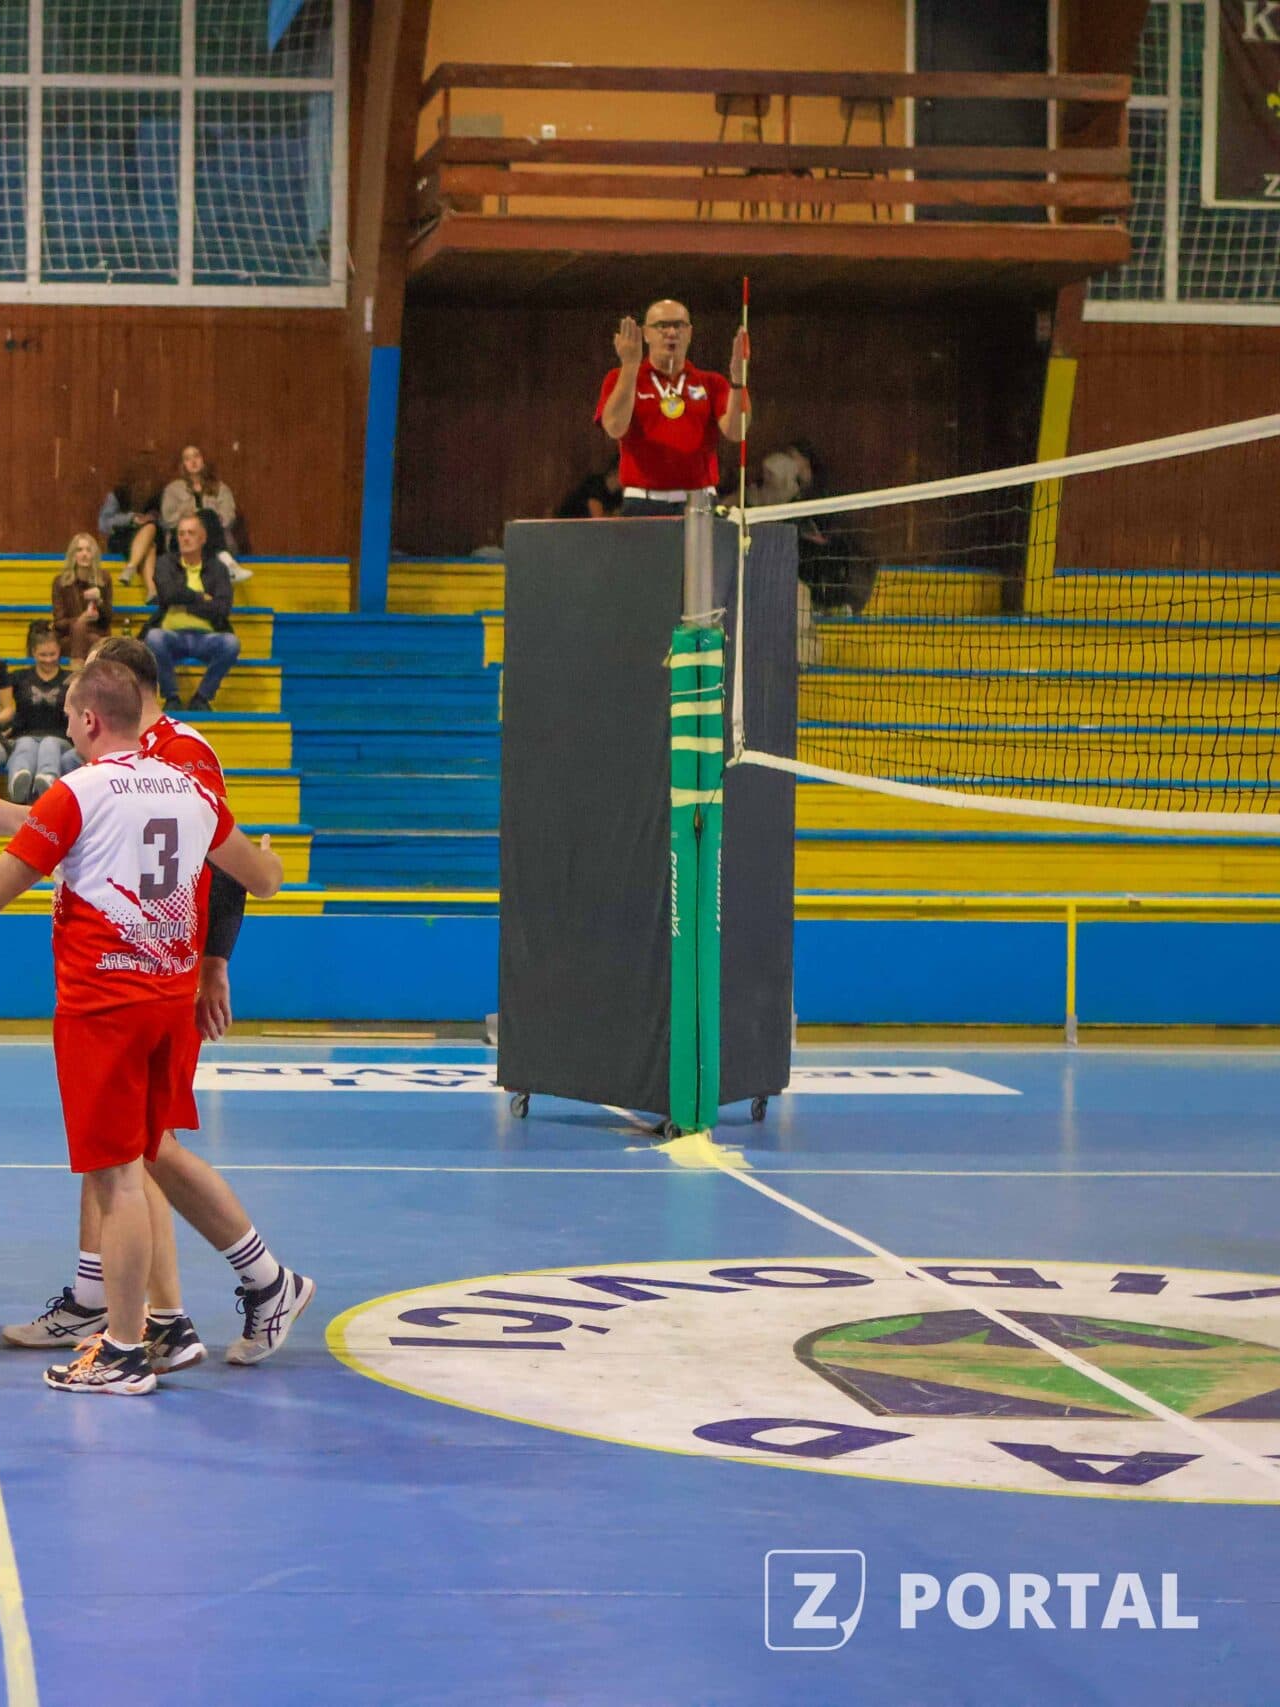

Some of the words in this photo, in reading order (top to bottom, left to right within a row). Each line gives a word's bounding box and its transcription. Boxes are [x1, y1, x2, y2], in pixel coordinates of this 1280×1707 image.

[110, 779, 135, 795] OK
[135, 777, 191, 795] KRIVAJA
[139, 818, 178, 900] 3
